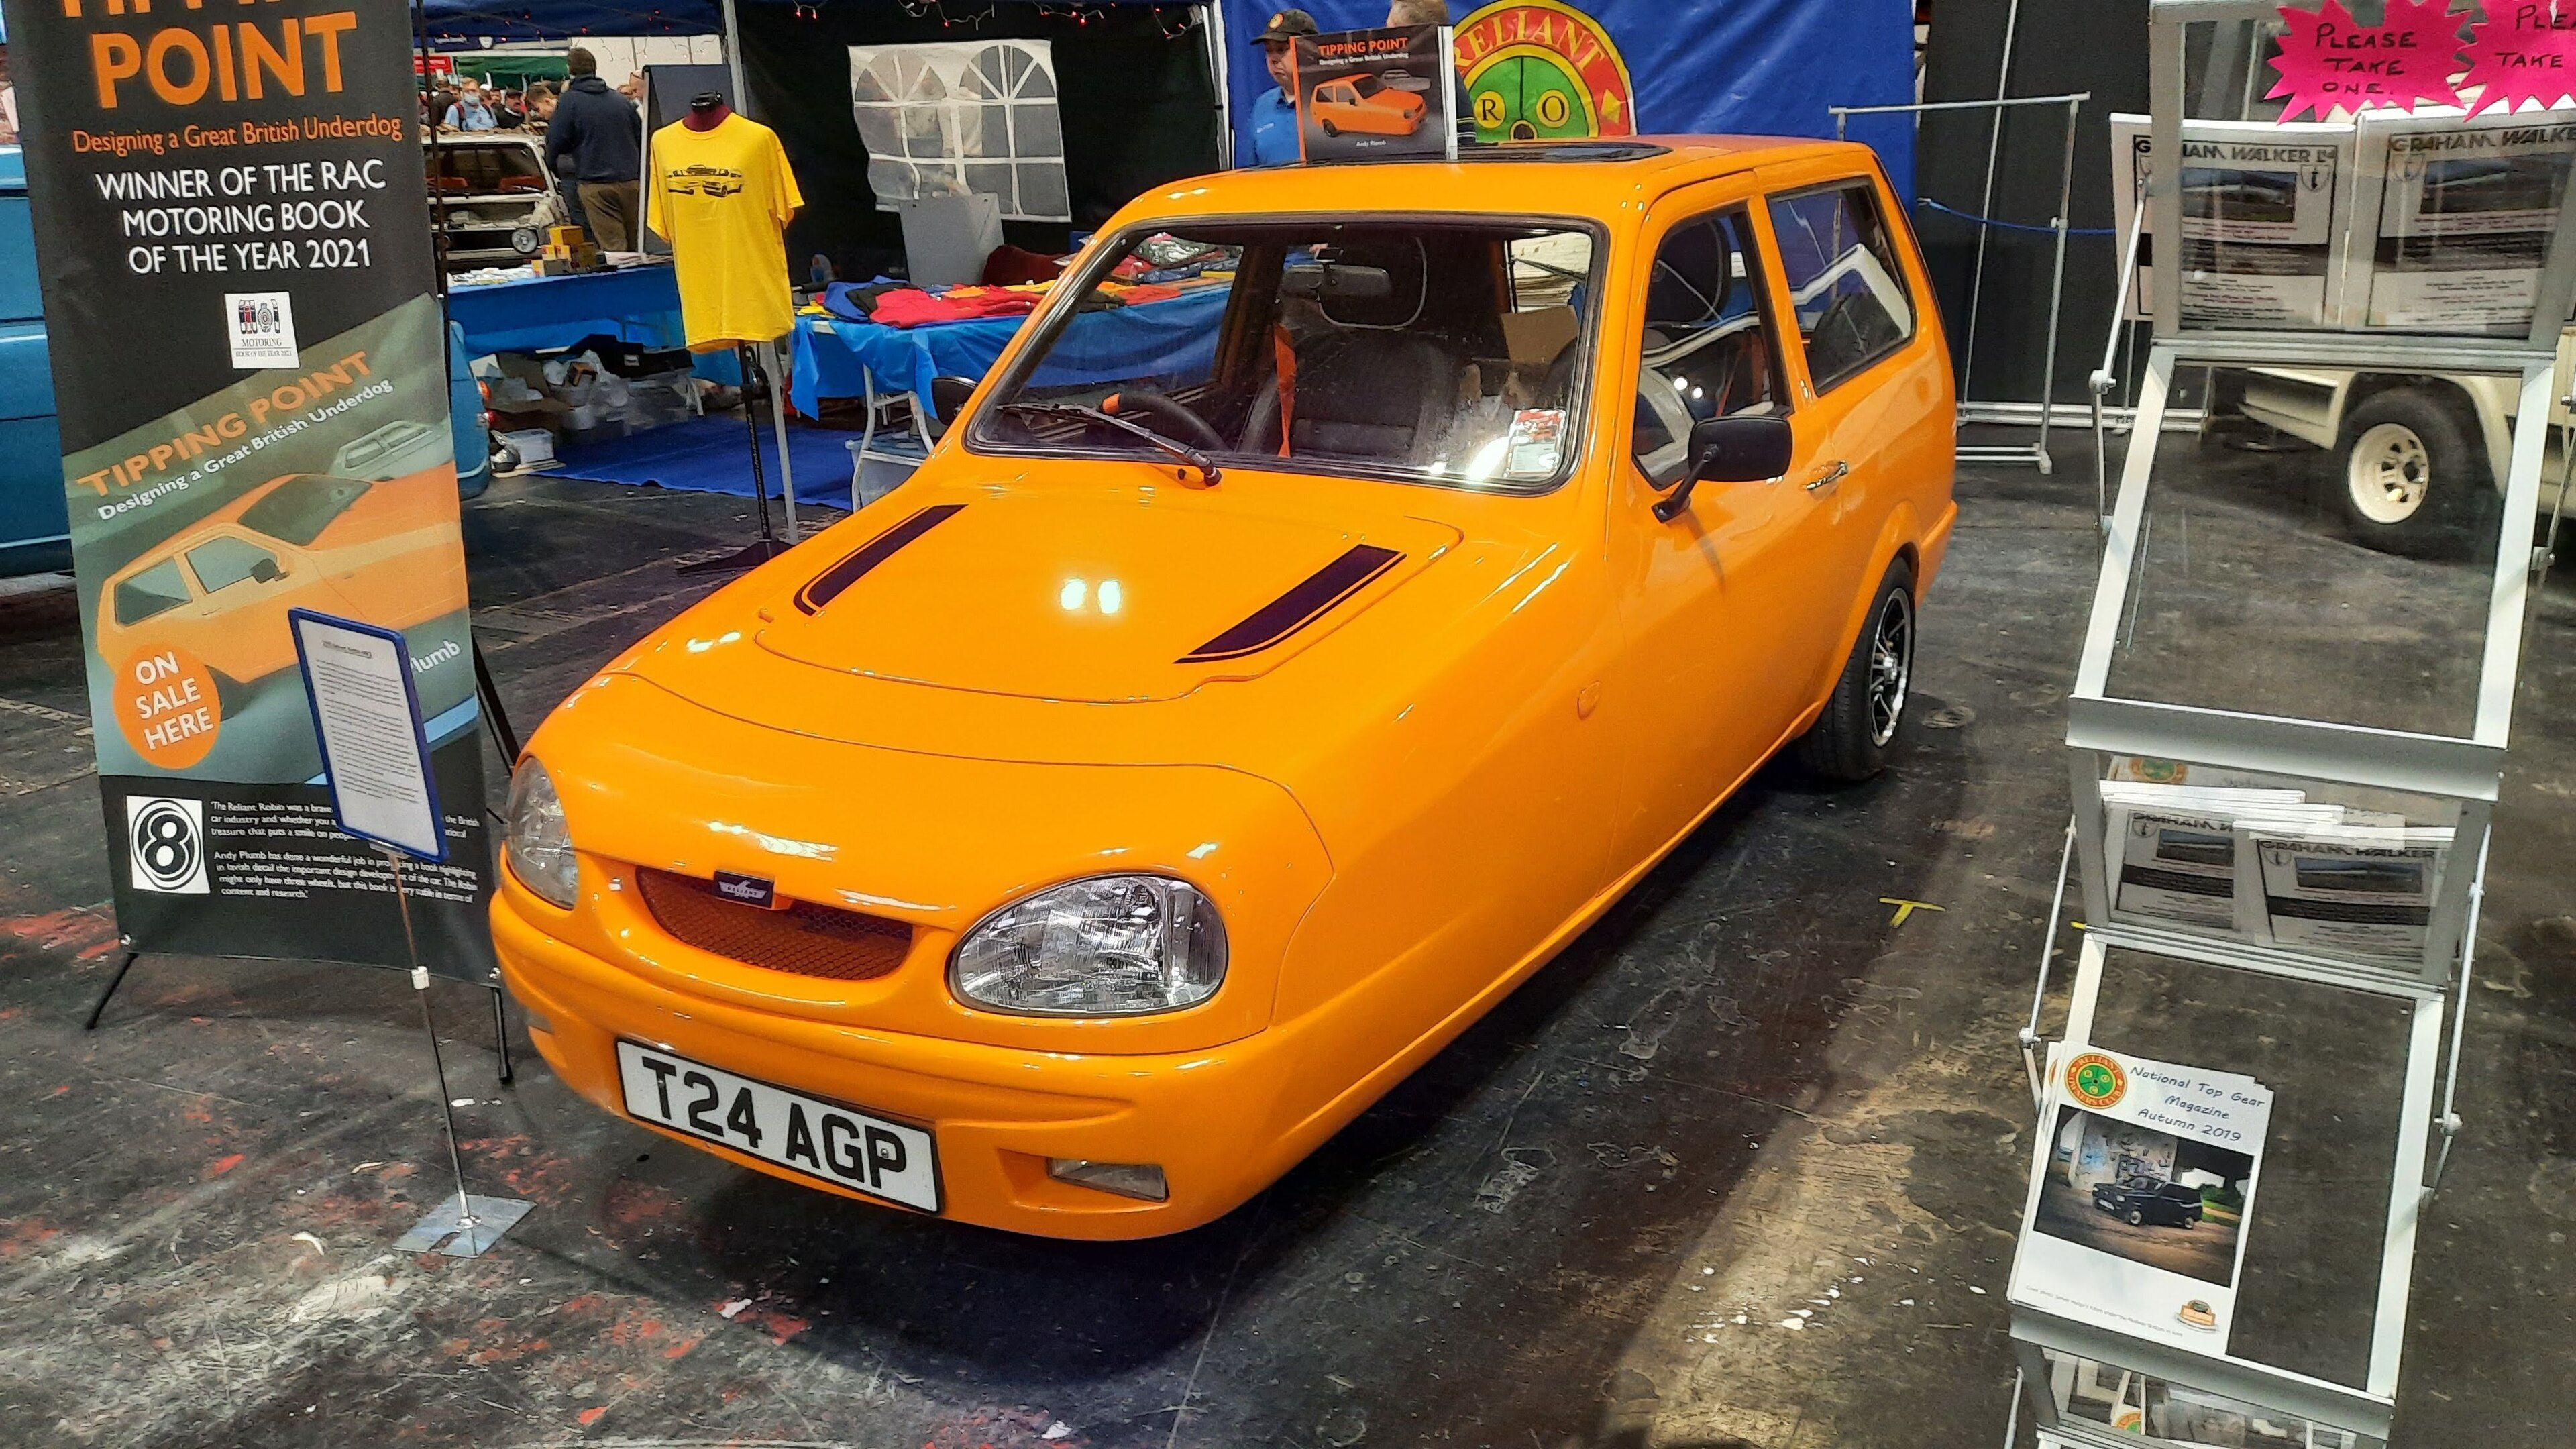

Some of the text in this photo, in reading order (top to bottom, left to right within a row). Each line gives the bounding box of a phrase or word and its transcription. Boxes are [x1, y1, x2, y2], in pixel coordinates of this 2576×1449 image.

[2516, 5, 2576, 31] PLE
[1318, 36, 1408, 57] TIPPING POINT
[1454, 11, 1607, 72] RELIANT
[2315, 22, 2418, 49] PLEASE
[91, 11, 358, 109] POINT
[2322, 56, 2406, 76] TAKE
[2494, 52, 2564, 68] TAKE
[2321, 81, 2394, 95] ONE.
[1480, 99, 1502, 121] R
[1542, 96, 1565, 122] O
[72, 112, 403, 157] Designing a Great British Underdog
[2389, 133, 2496, 152] GRAHAM
[2231, 146, 2311, 162] WALKER
[95, 158, 386, 201] WINNER OF THE RAC
[123, 199, 370, 237] MOTORING BOOK
[129, 237, 372, 274] OF THE YEAR 2021
[242, 338, 282, 347] MOTORING
[76, 350, 372, 497] TIPPING POINT
[97, 378, 394, 521] Designing a Great British Underdog
[136, 651, 180, 685] ON
[411, 640, 461, 673] lumb
[136, 677, 203, 720] SALE
[143, 706, 215, 751] HERE
[223, 816, 260, 825] industry
[261, 814, 278, 823] and
[213, 851, 237, 861] Andy
[239, 851, 267, 860] Plumb
[2130, 1066, 2265, 1108] National Top Gear
[641, 1055, 907, 1191] T24 AGP
[2165, 1095, 2230, 1120] Magazine
[2137, 1108, 2242, 1142] Autumn 2019
